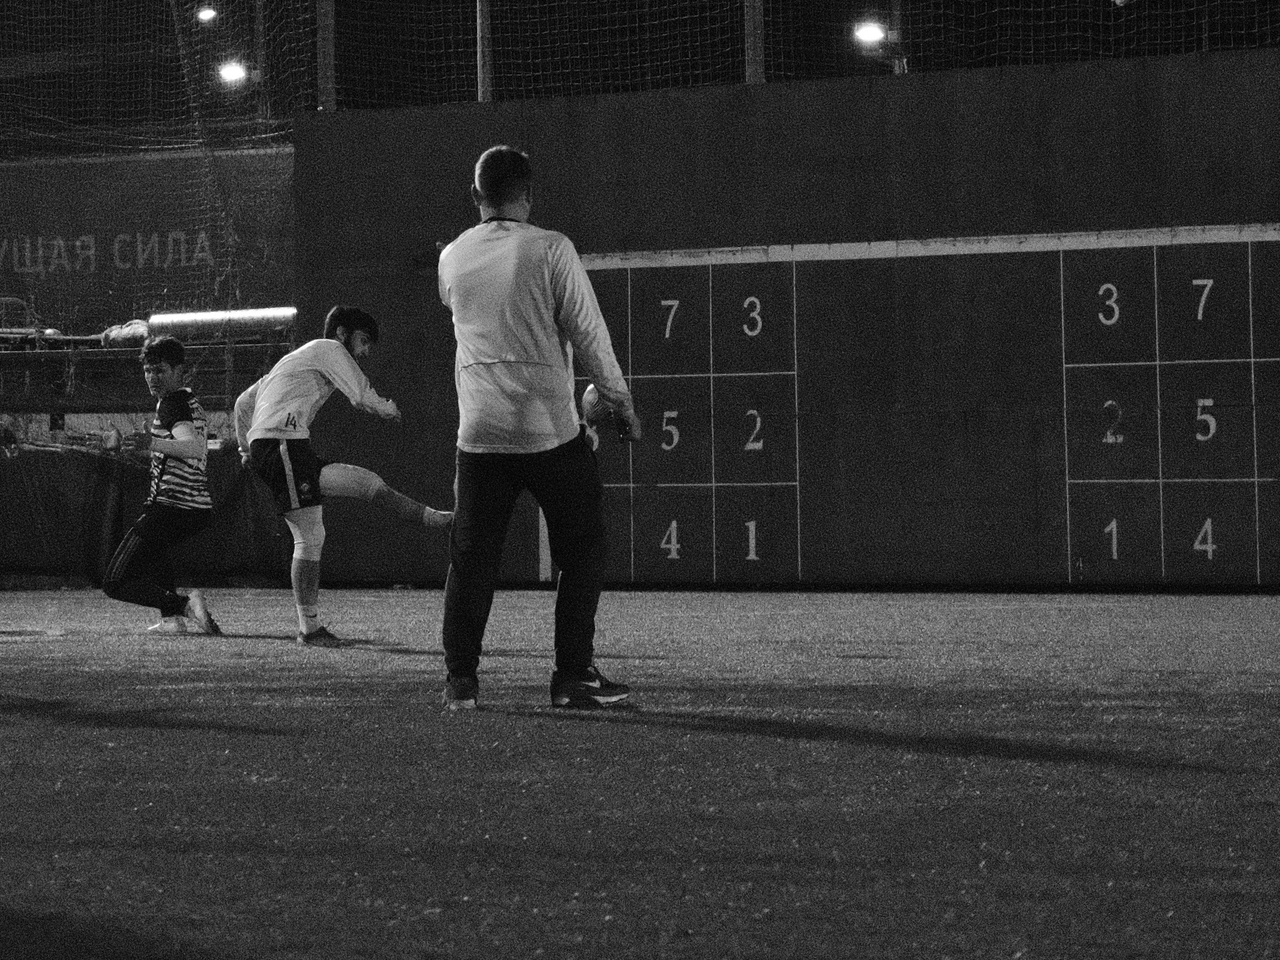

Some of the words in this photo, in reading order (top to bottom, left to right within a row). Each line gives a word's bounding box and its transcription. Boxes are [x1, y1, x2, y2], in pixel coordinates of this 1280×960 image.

[113, 230, 215, 270] СИЛА
[660, 300, 680, 339] 7
[742, 296, 763, 337] 3
[1097, 283, 1120, 326] 3
[1192, 279, 1214, 321] 7
[284, 412, 297, 431] 14
[660, 410, 680, 451] 5
[743, 409, 764, 451] 2
[1101, 399, 1124, 444] 2
[1195, 398, 1217, 442] 5
[659, 520, 681, 560] 4
[743, 520, 761, 561] 1
[1103, 518, 1118, 560] 1
[1193, 518, 1217, 560] 4
